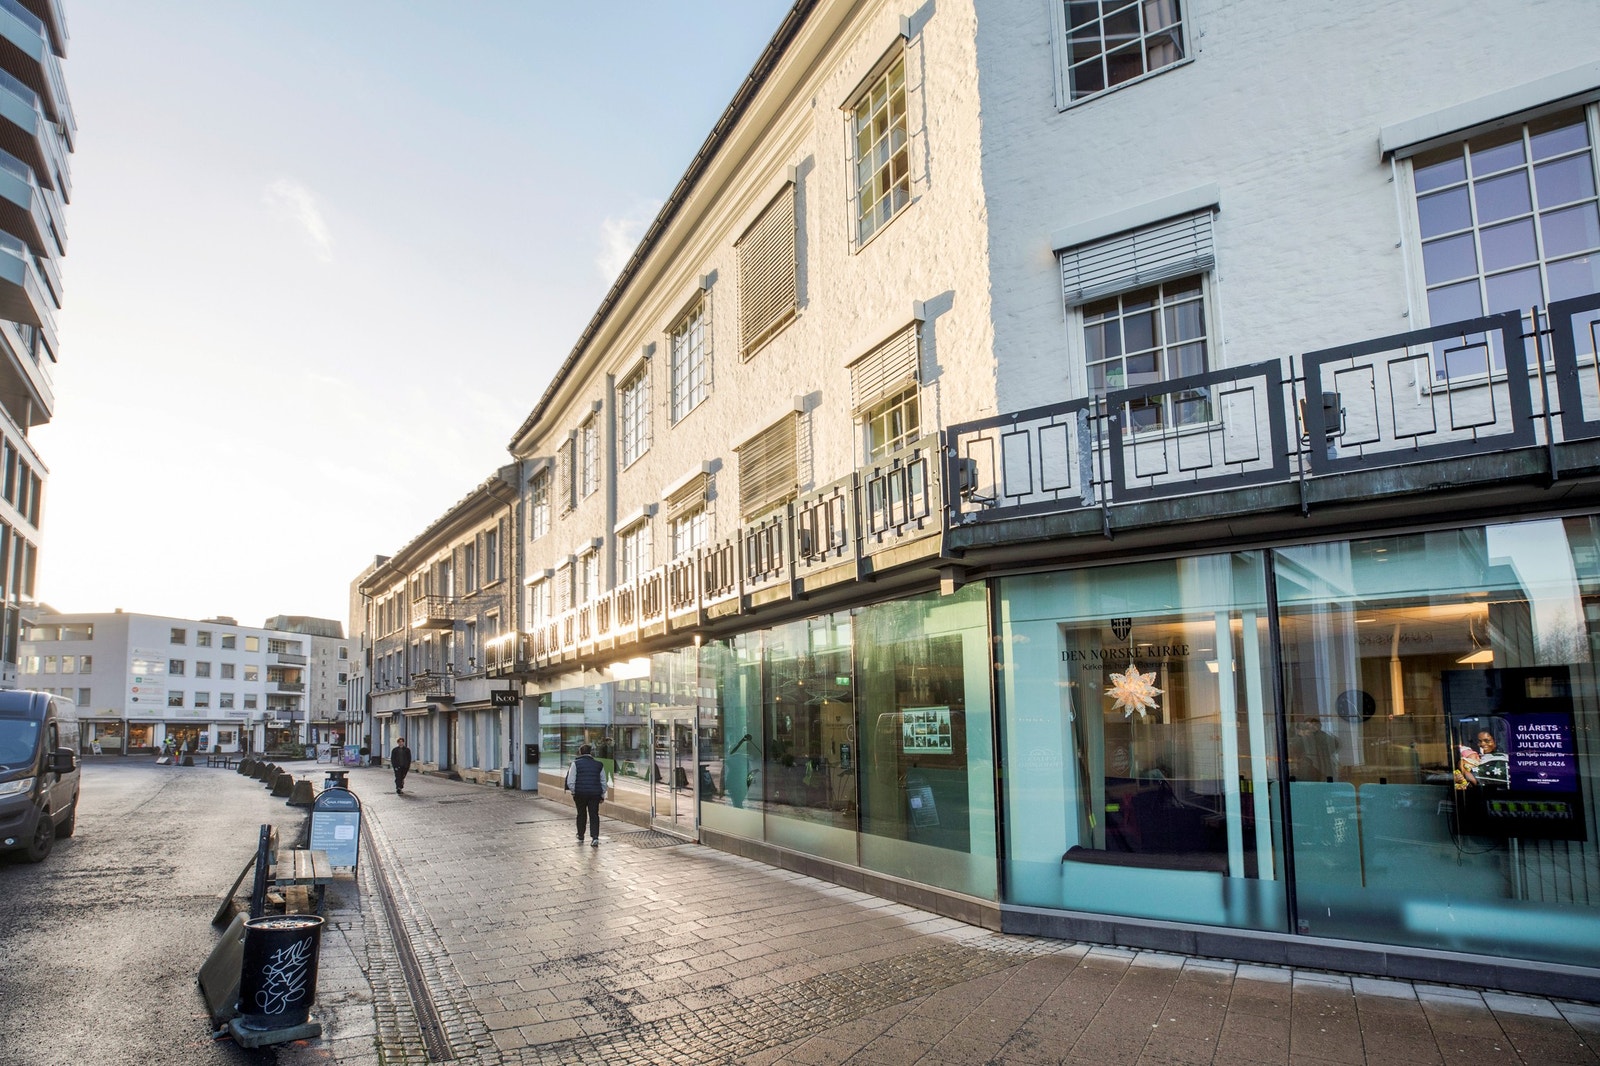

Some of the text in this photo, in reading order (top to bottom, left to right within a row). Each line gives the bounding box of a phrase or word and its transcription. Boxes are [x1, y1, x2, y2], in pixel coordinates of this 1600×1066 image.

[1062, 644, 1190, 661] DEN NORSKE KIRKE
